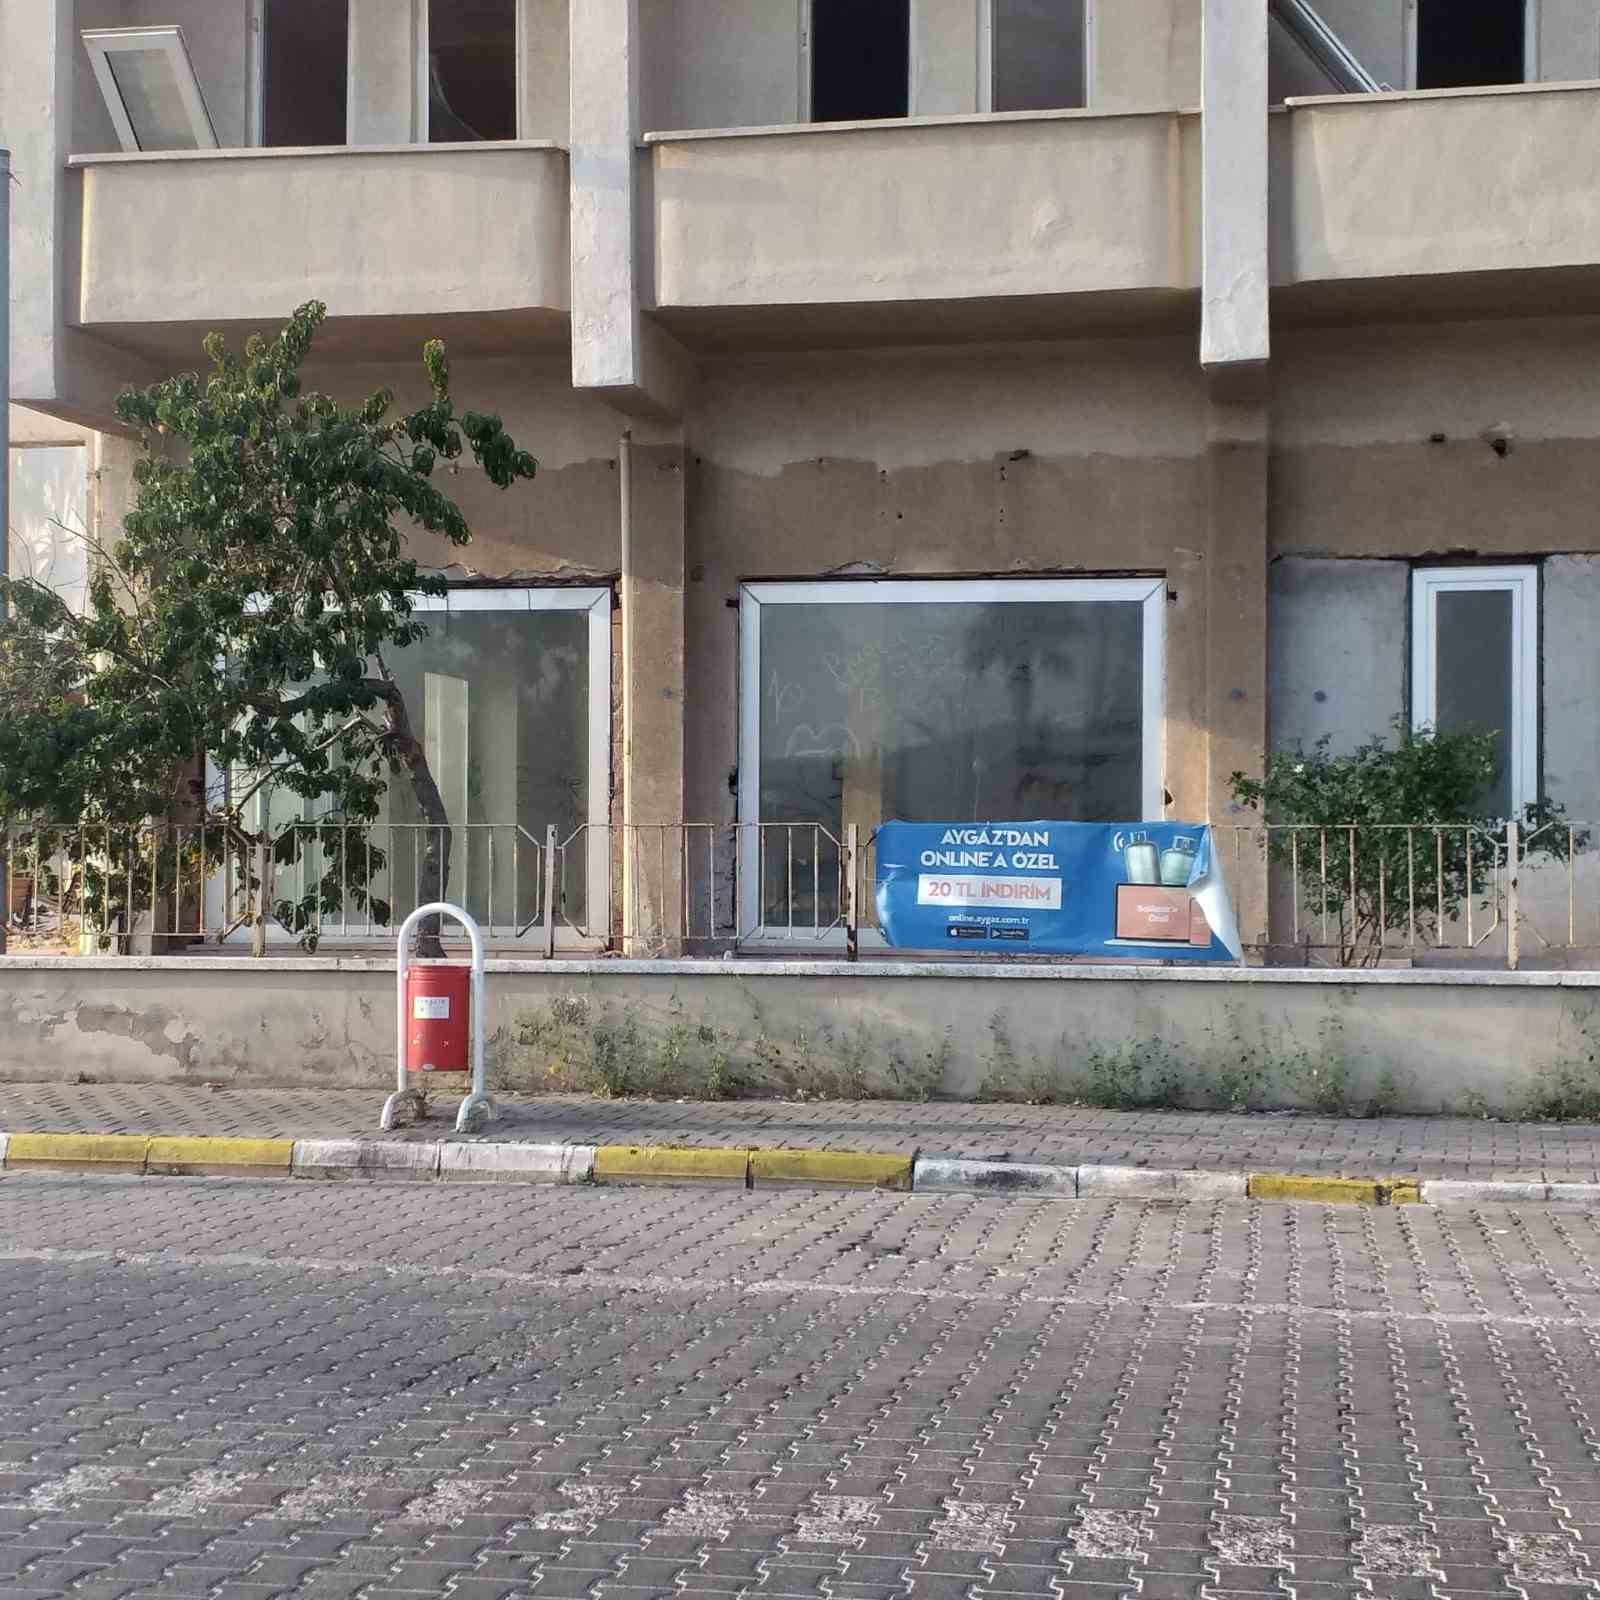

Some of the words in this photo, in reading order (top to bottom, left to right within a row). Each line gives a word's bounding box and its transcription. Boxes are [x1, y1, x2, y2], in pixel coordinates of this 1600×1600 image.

[940, 830, 1049, 846] AYGAZ'DAN
[1012, 851, 1059, 869] ÖZEL
[928, 882, 952, 897] 20
[956, 883, 977, 898] TL
